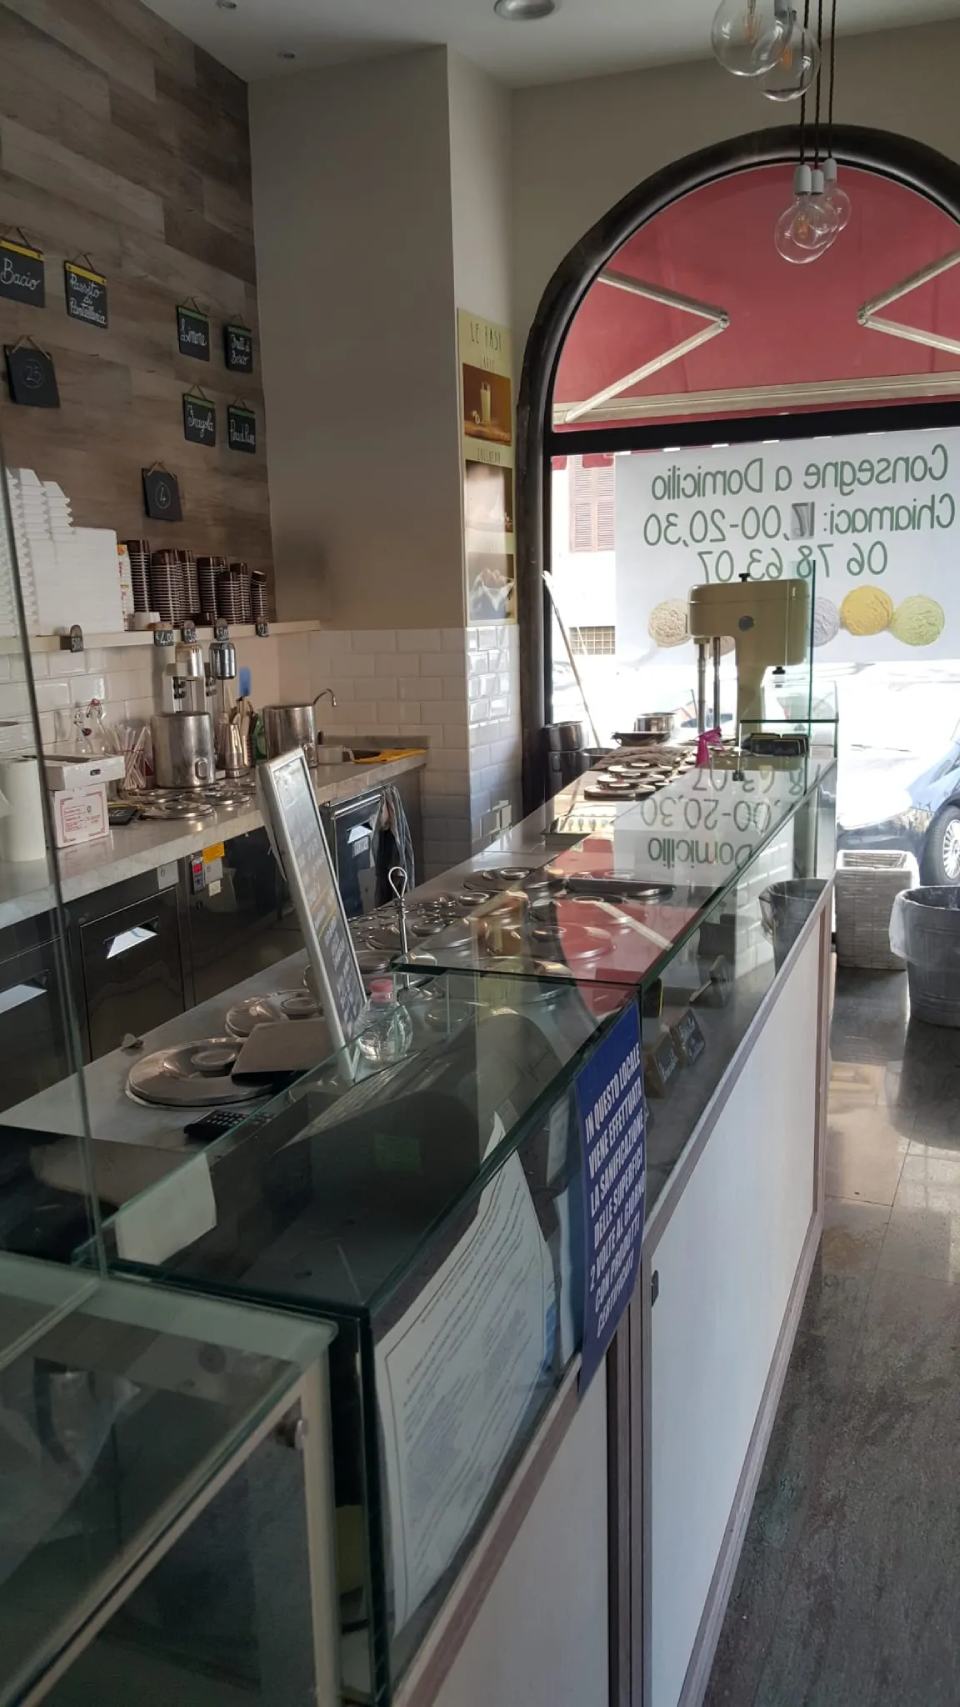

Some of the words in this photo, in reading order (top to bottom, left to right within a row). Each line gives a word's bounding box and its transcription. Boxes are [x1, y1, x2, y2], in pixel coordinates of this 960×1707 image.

[0, 257, 41, 291] Bacio
[585, 1110, 595, 1143] IN
[594, 1073, 619, 1126] QUESTO
[619, 1042, 641, 1092] LOCALE
[589, 1130, 609, 1179] VIENE
[609, 1077, 642, 1147] EFFETTUATA
[591, 1187, 600, 1218] LA
[600, 1108, 644, 1201] SANIFICAZIONE
[594, 1198, 613, 1250] DELLE
[613, 1143, 643, 1213] SUPERFICI
[589, 1264, 596, 1293] 2
